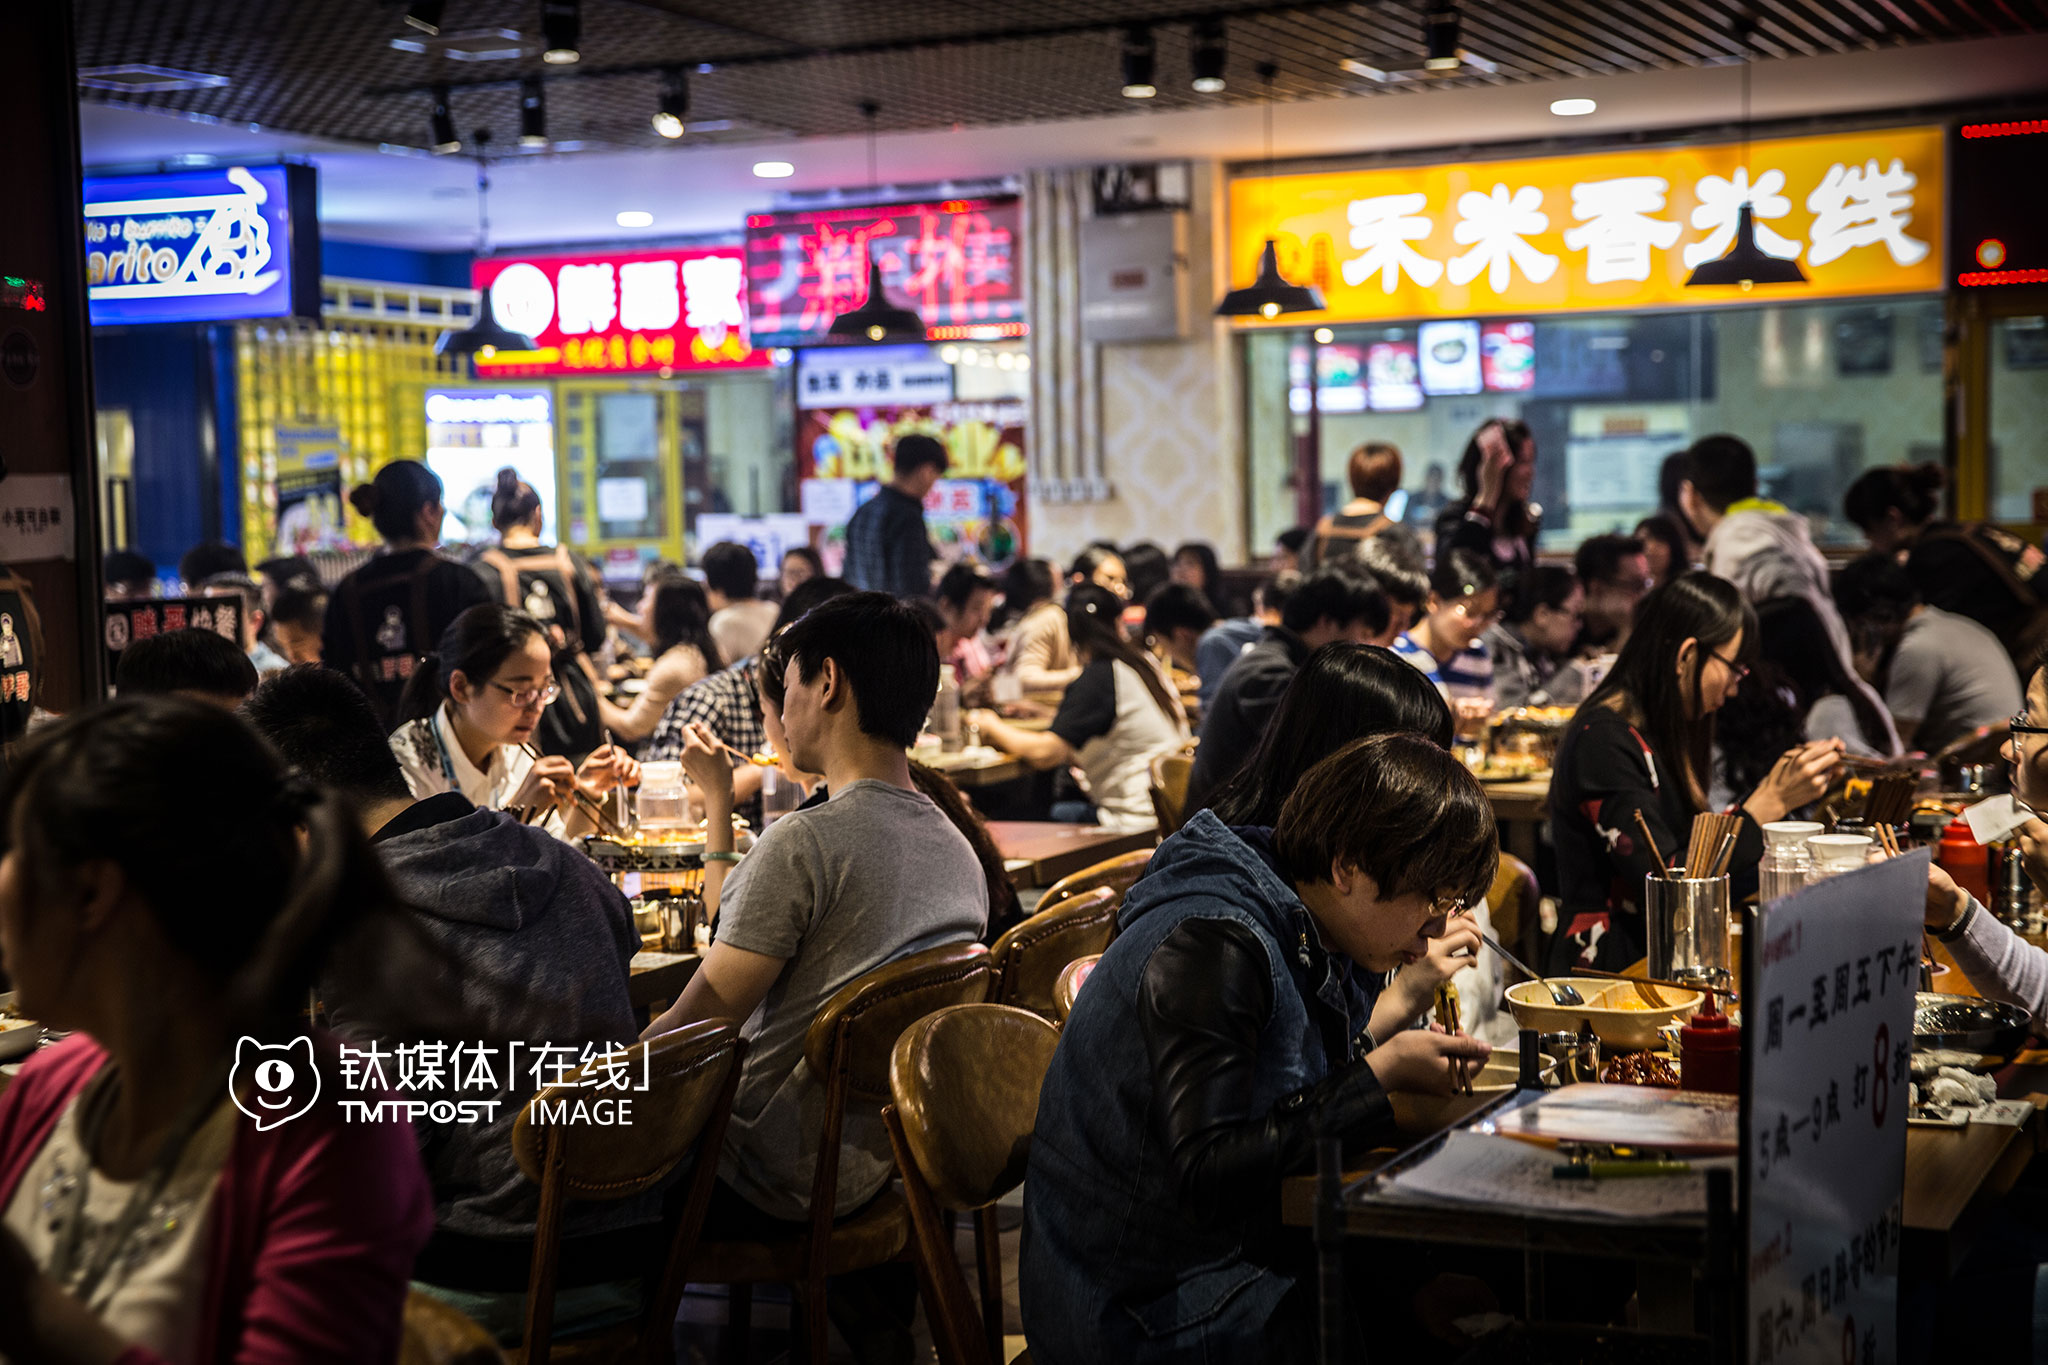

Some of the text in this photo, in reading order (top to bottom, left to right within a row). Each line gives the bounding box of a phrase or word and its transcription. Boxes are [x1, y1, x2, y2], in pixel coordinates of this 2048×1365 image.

[1341, 157, 1931, 294] 禾米香米线
[1764, 938, 1918, 1055] 周一至周五下午
